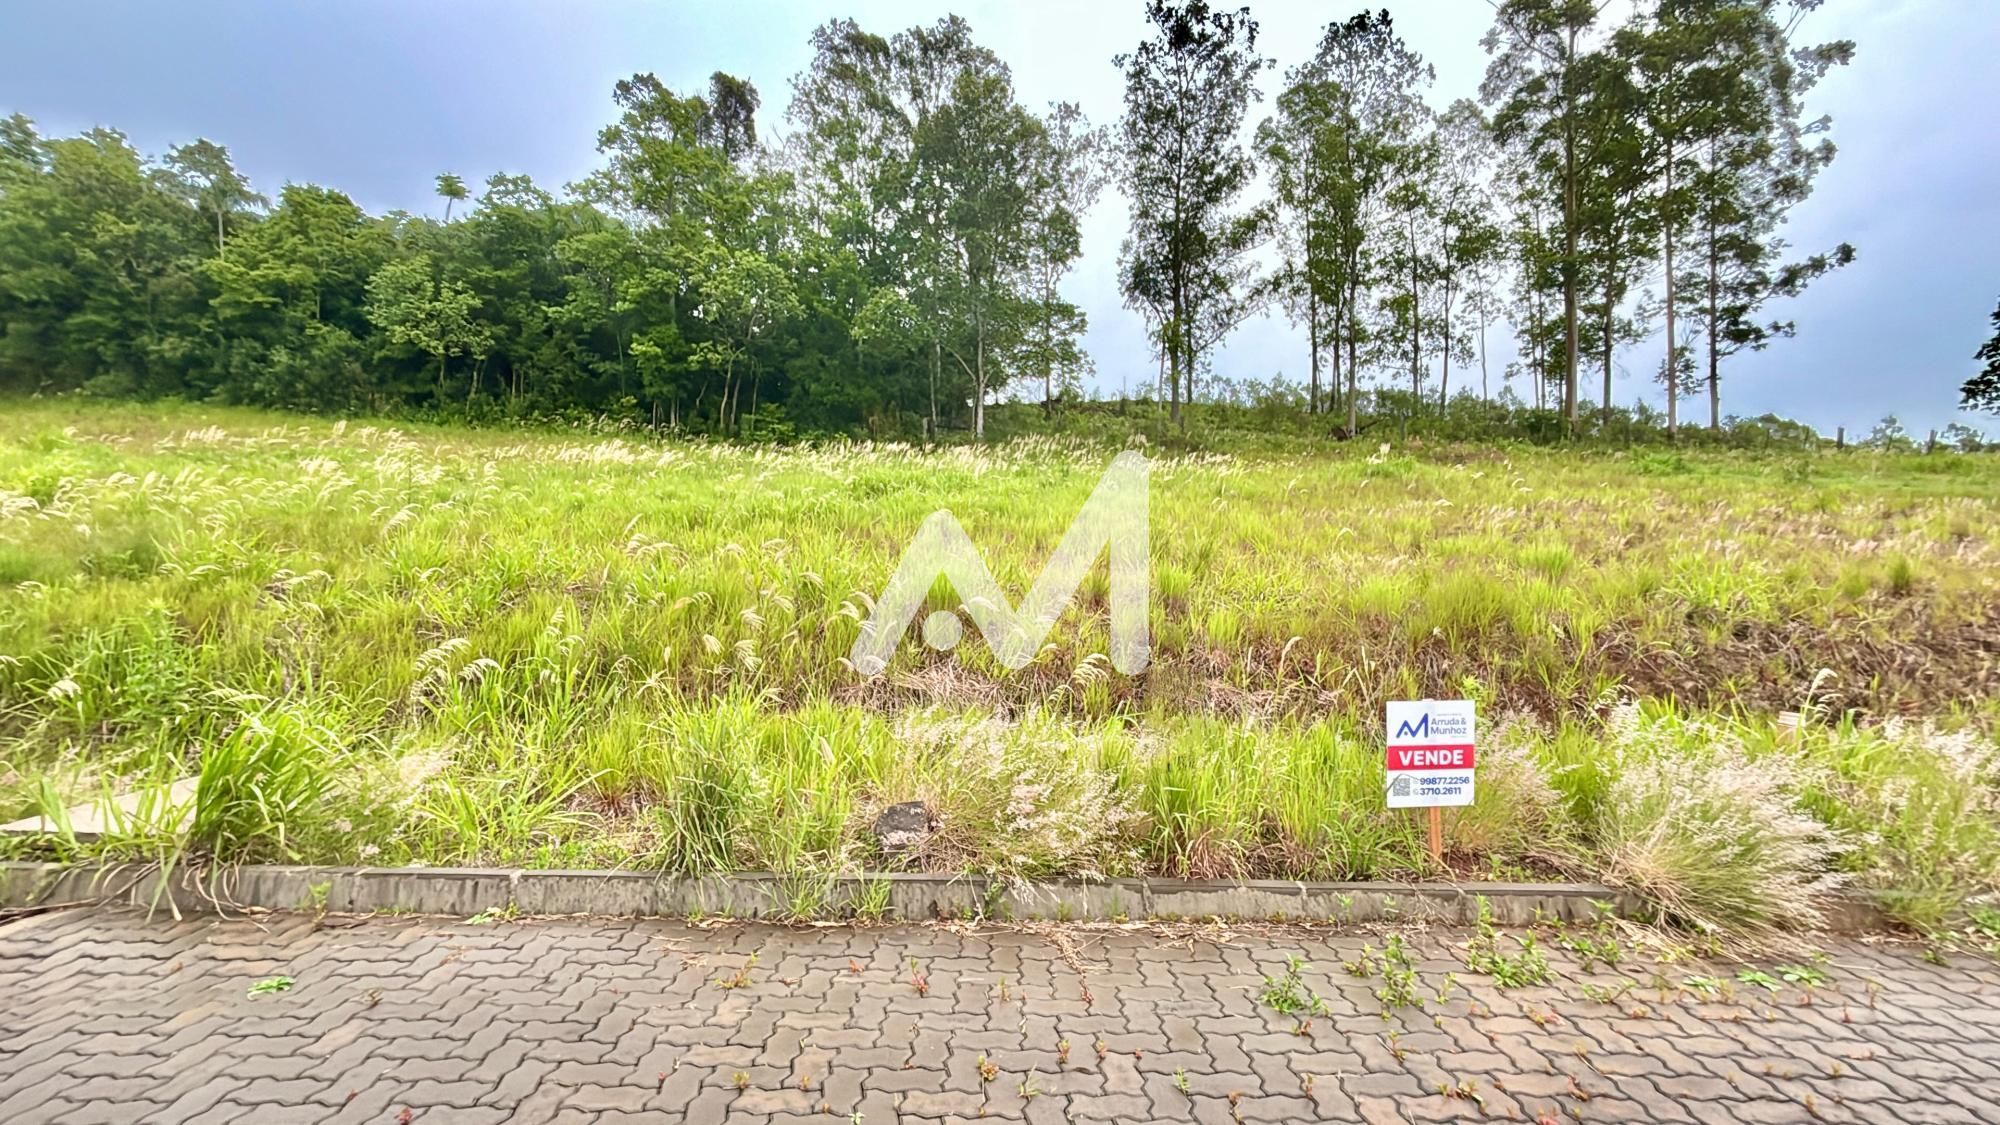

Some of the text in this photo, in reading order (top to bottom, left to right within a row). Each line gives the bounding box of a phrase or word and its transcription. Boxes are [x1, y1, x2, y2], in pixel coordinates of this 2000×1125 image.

[1431, 726, 1467, 735] Munhoz
[1398, 749, 1464, 766] VENDE
[1419, 787, 1462, 795] 3710.2611
